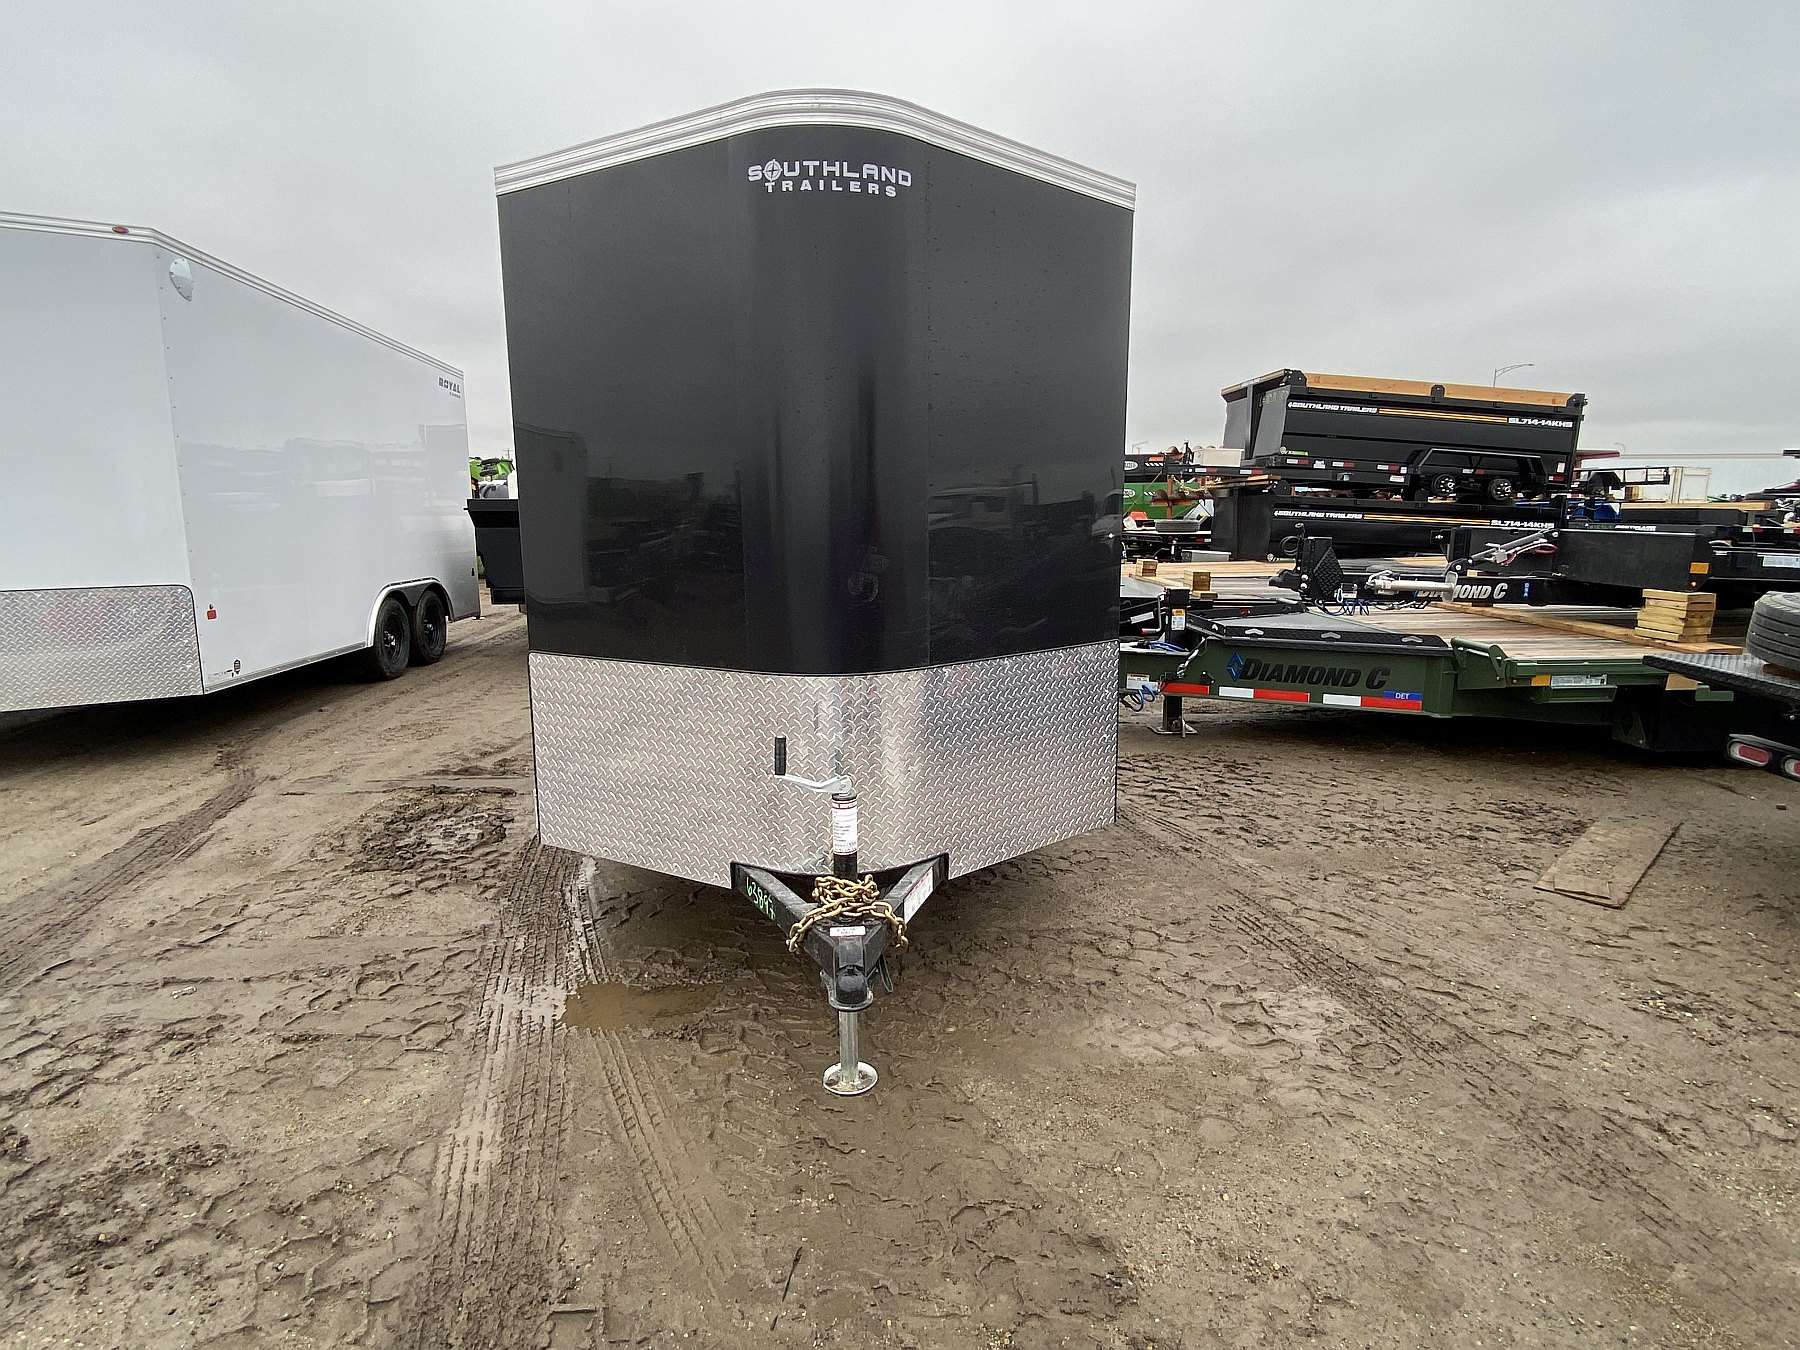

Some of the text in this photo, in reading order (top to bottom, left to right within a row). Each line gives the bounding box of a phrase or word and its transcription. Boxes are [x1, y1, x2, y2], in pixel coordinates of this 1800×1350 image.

[748, 159, 912, 187] SOUTHLAND
[765, 180, 897, 198] TRAILERS
[438, 377, 461, 393] ROYAL
[1292, 402, 1378, 413] SOUTHLAND TRAILERS
[1493, 582, 1508, 599] C
[1241, 658, 1391, 690] DIAMOND C
